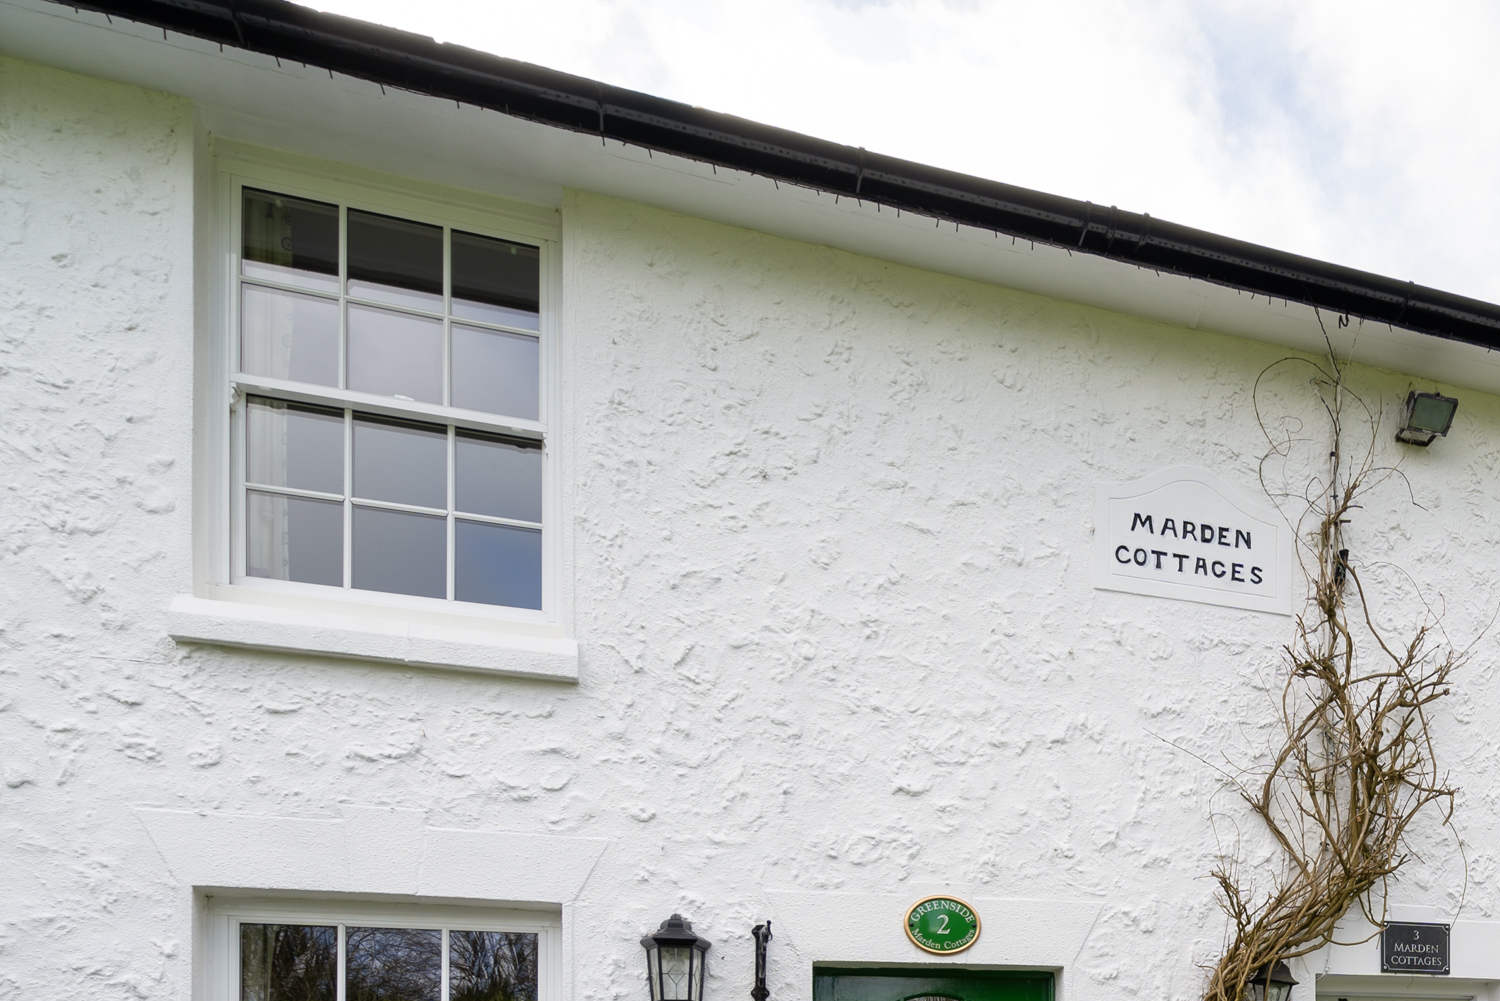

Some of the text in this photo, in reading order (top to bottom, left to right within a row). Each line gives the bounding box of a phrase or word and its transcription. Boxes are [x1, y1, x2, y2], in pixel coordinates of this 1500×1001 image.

[1130, 512, 1252, 550] MARDEN
[1115, 545, 1264, 585] COTTAGES
[910, 900, 975, 924] GREENSIDE
[936, 914, 951, 935] 2
[1413, 930, 1420, 940] 3
[911, 928, 976, 949] Marden Cottages
[1394, 942, 1439, 953] MARDEN
[1391, 955, 1442, 966] COTTAGES
